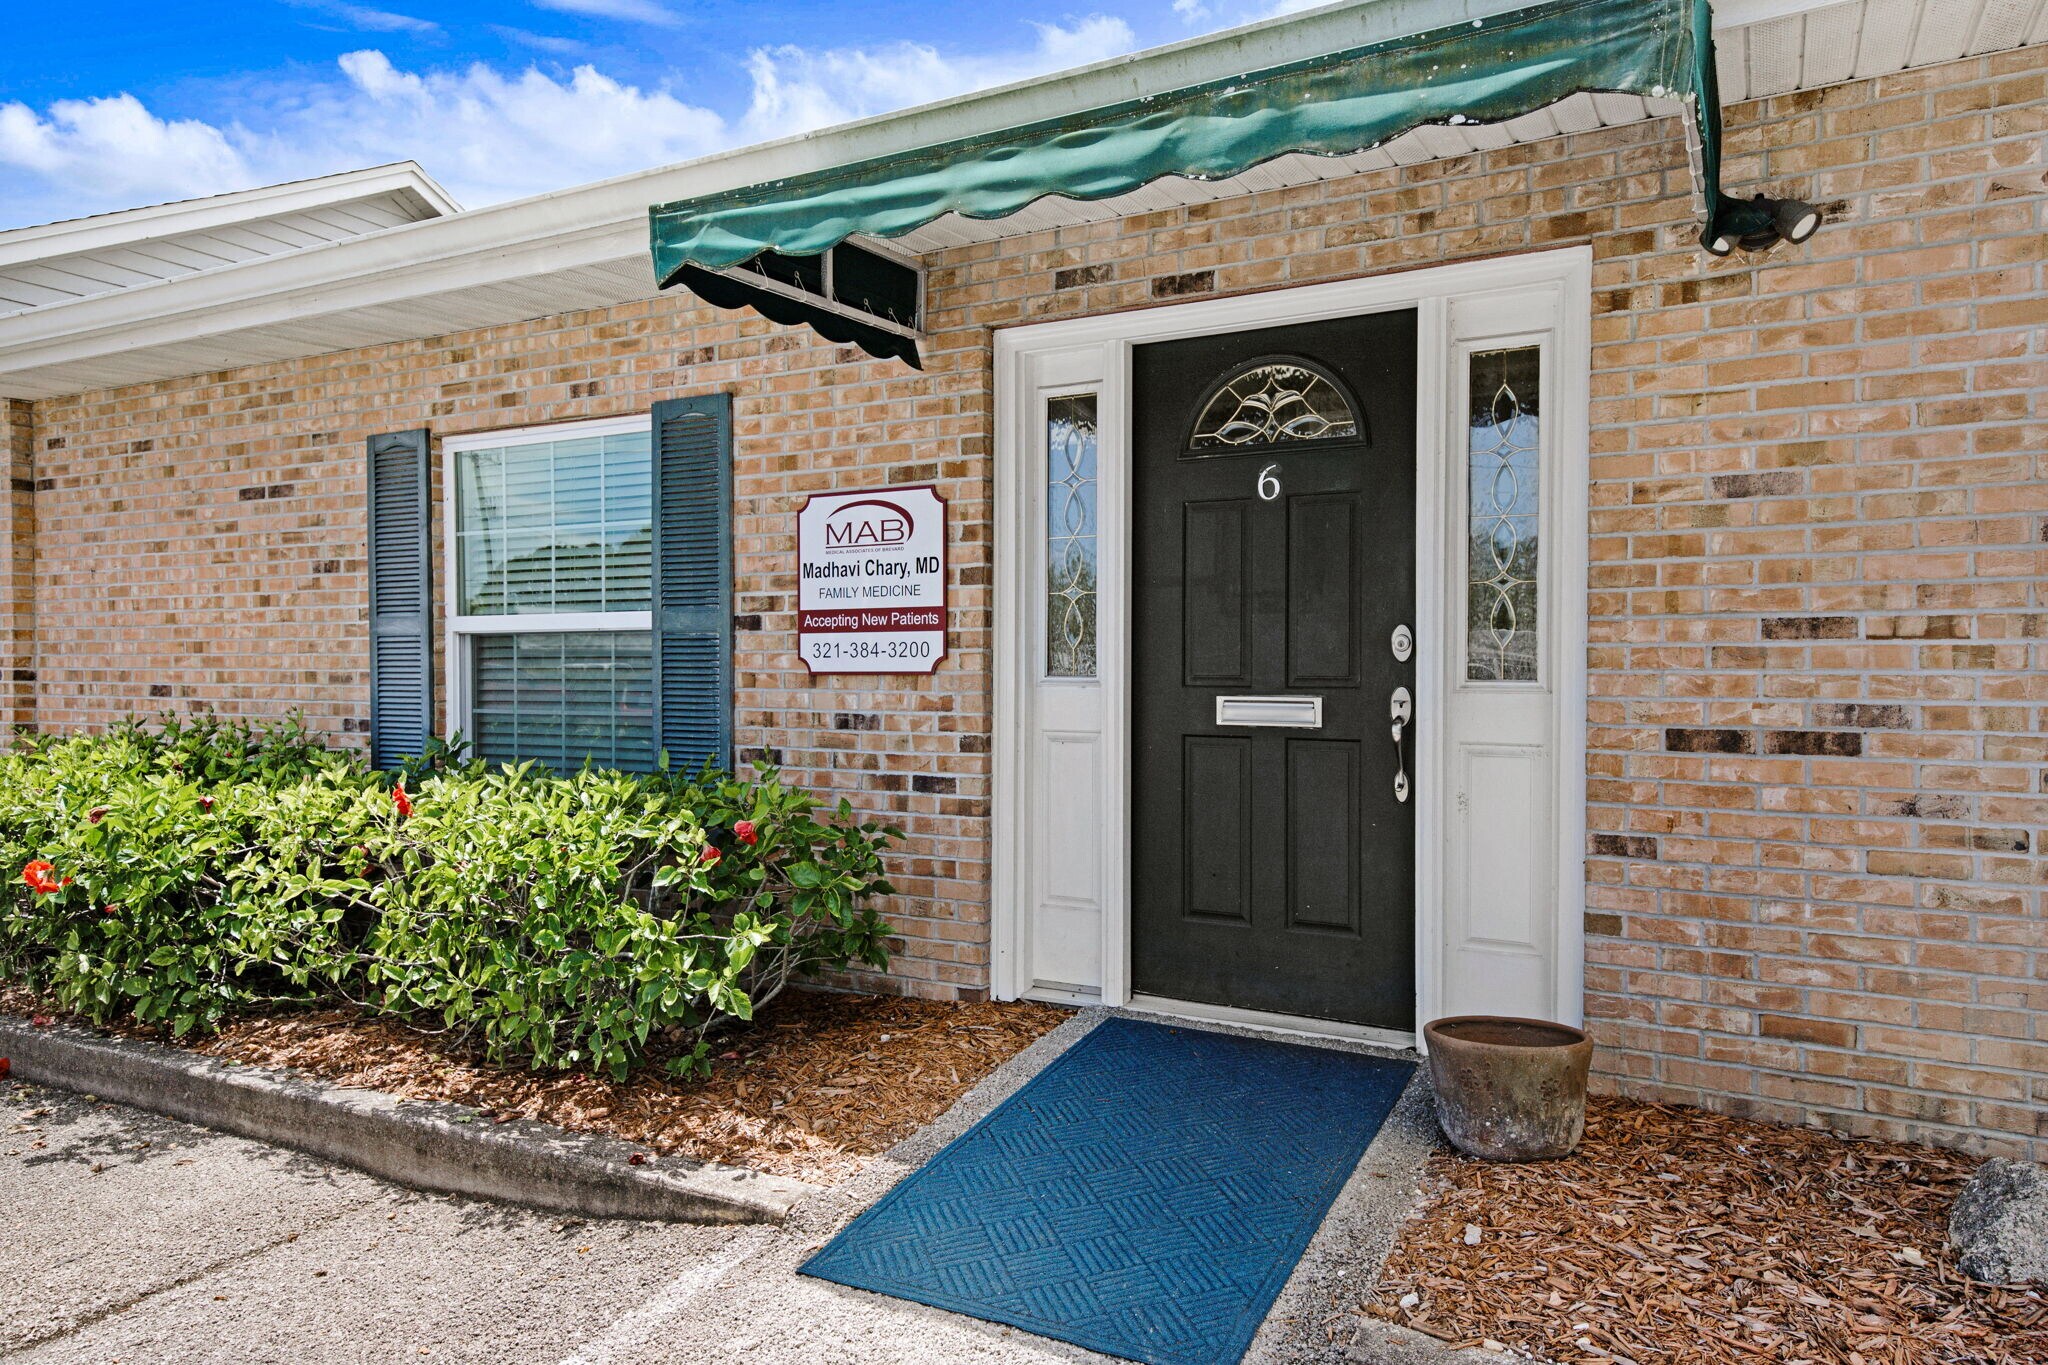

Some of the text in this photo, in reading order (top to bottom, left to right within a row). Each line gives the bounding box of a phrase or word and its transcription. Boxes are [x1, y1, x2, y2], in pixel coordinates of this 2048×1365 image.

[1257, 464, 1280, 500] 6
[825, 519, 905, 545] MAB
[803, 556, 940, 579] Madhavi Chary, MD
[819, 584, 921, 599] FAMILY MEDICINE
[804, 612, 939, 629] Accepting New Patients
[812, 641, 930, 659] 321-384-3200
